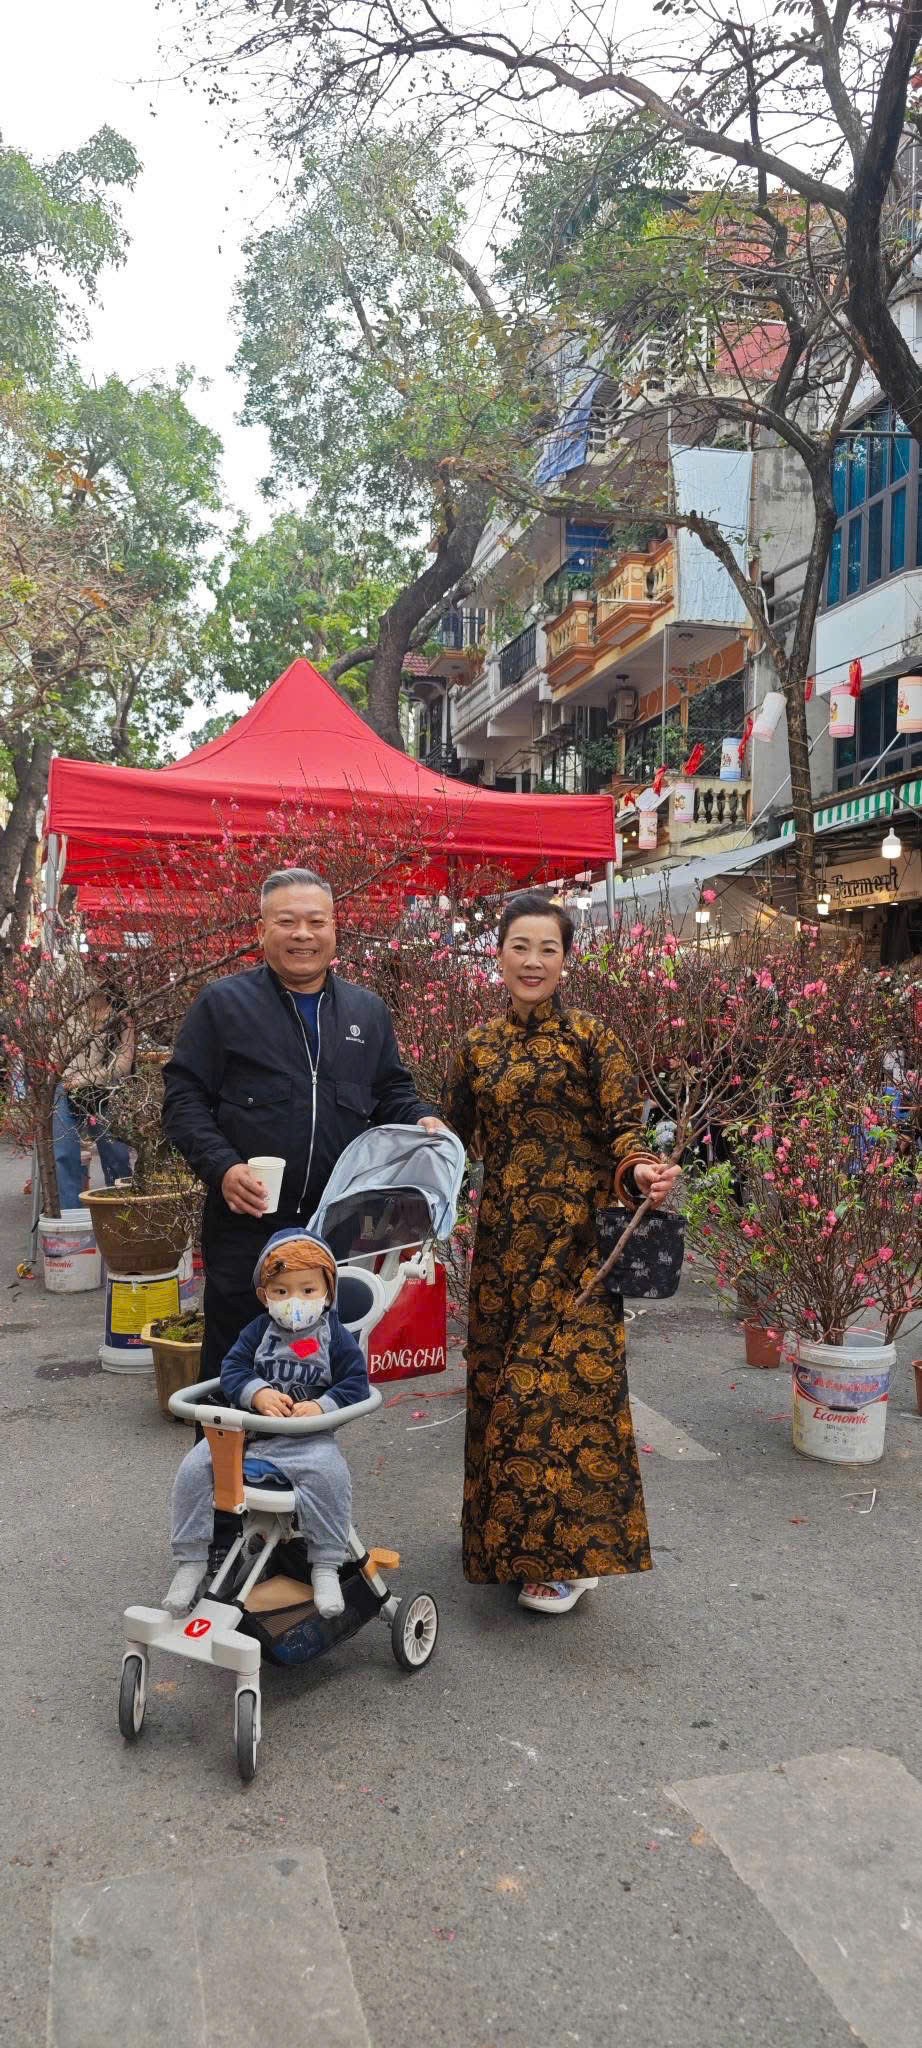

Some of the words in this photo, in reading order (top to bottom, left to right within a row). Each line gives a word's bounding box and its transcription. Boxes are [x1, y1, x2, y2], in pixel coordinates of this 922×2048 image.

[263, 1335, 282, 1357] I
[413, 1346, 445, 1368] CHA
[256, 1360, 325, 1386] MUM
[812, 1407, 869, 1425] Economic
